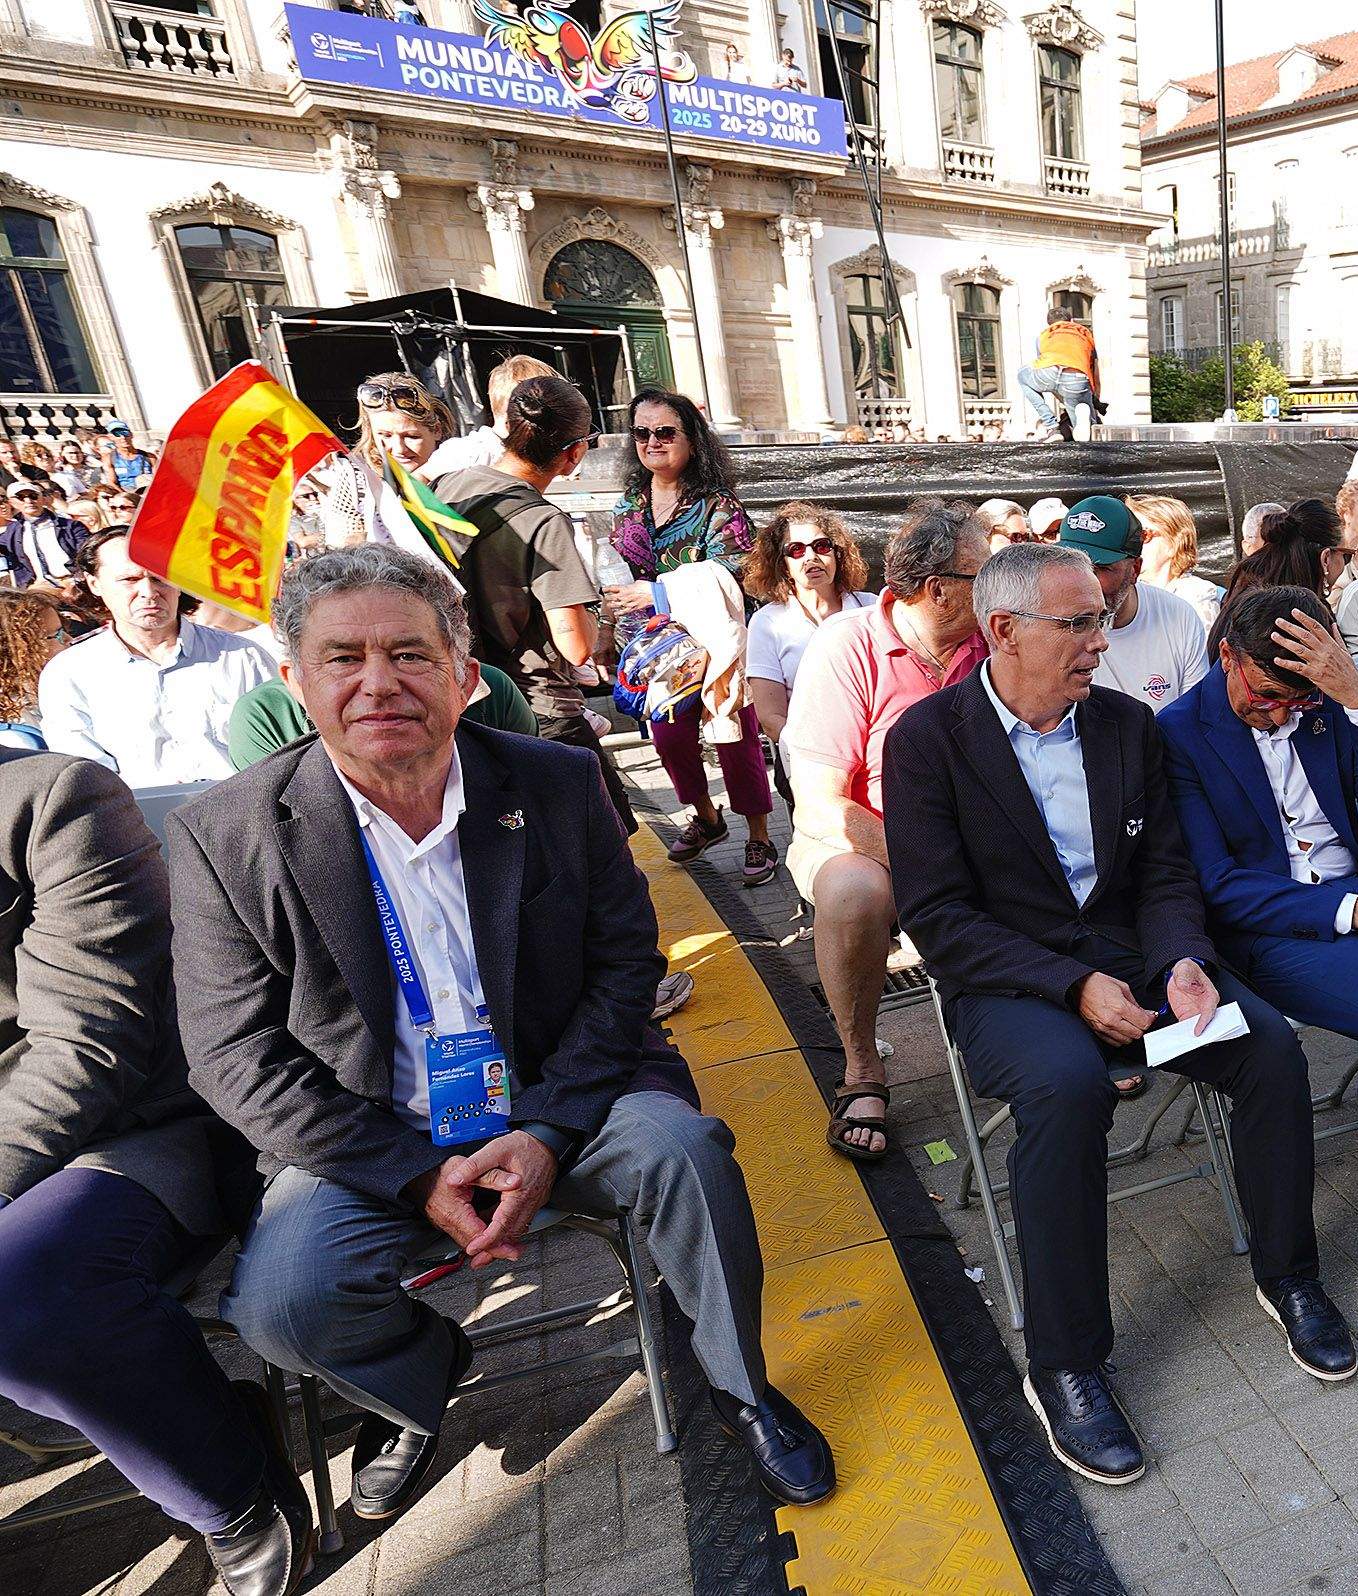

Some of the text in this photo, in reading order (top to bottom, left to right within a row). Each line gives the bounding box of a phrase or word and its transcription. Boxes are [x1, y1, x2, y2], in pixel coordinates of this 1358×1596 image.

[395, 34, 544, 83] MUNDIAL
[400, 63, 579, 110] PONTEVEDRA
[668, 83, 818, 128] MULTISPORT
[671, 108, 821, 146] 2025 20-29 XUÑO
[372, 880, 414, 984] 2025 PONTEVEDRA
